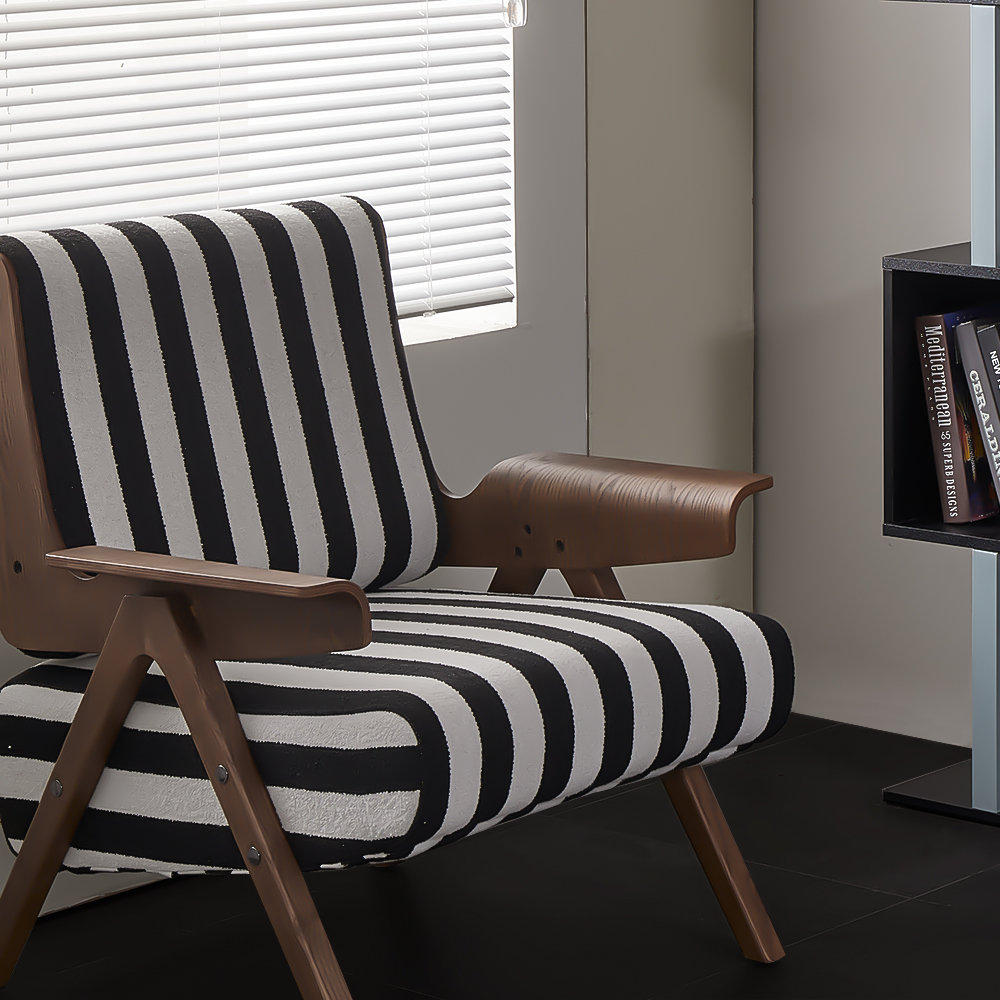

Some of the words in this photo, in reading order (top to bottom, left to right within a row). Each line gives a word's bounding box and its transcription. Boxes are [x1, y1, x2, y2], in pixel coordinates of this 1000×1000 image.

[924, 325, 952, 427] Mediterranean
[942, 442, 954, 476] SUPERB
[946, 479, 959, 517] DESIGNS
